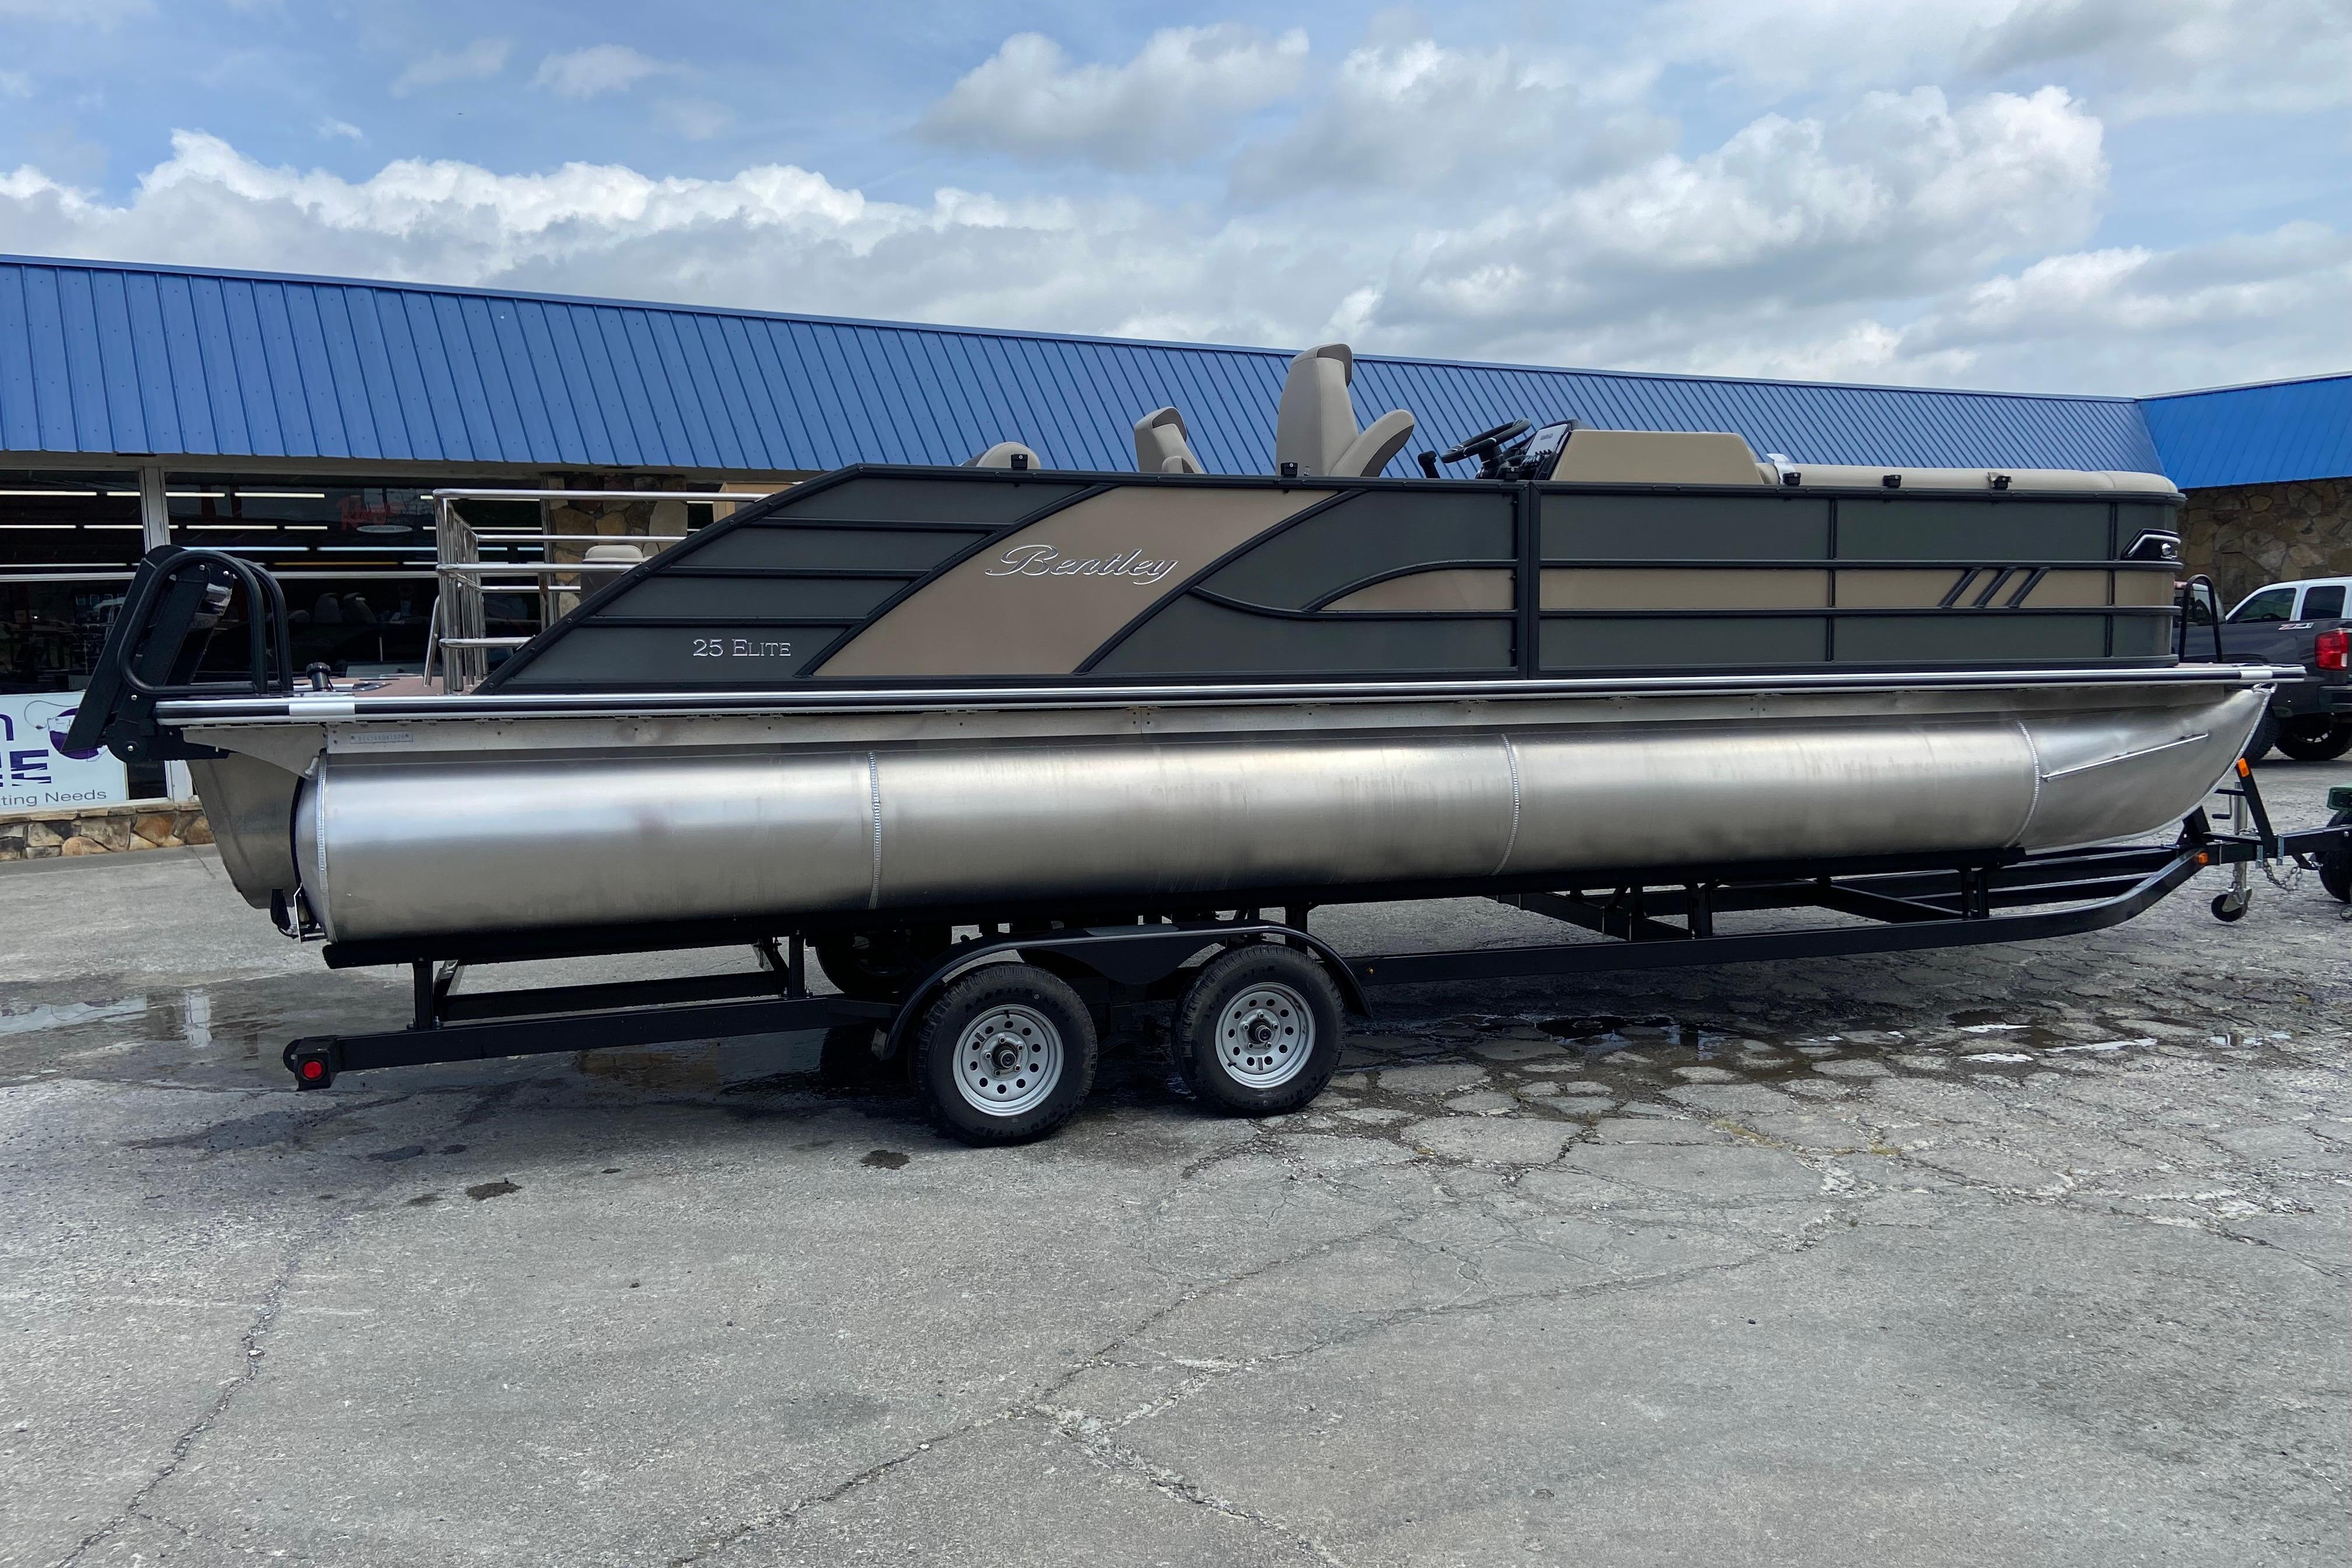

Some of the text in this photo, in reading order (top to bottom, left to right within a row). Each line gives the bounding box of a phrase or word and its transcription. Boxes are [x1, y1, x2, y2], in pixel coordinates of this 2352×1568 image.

[985, 544, 1179, 585] Bentley
[692, 639, 724, 657] 25
[45, 789, 107, 803] Needs
